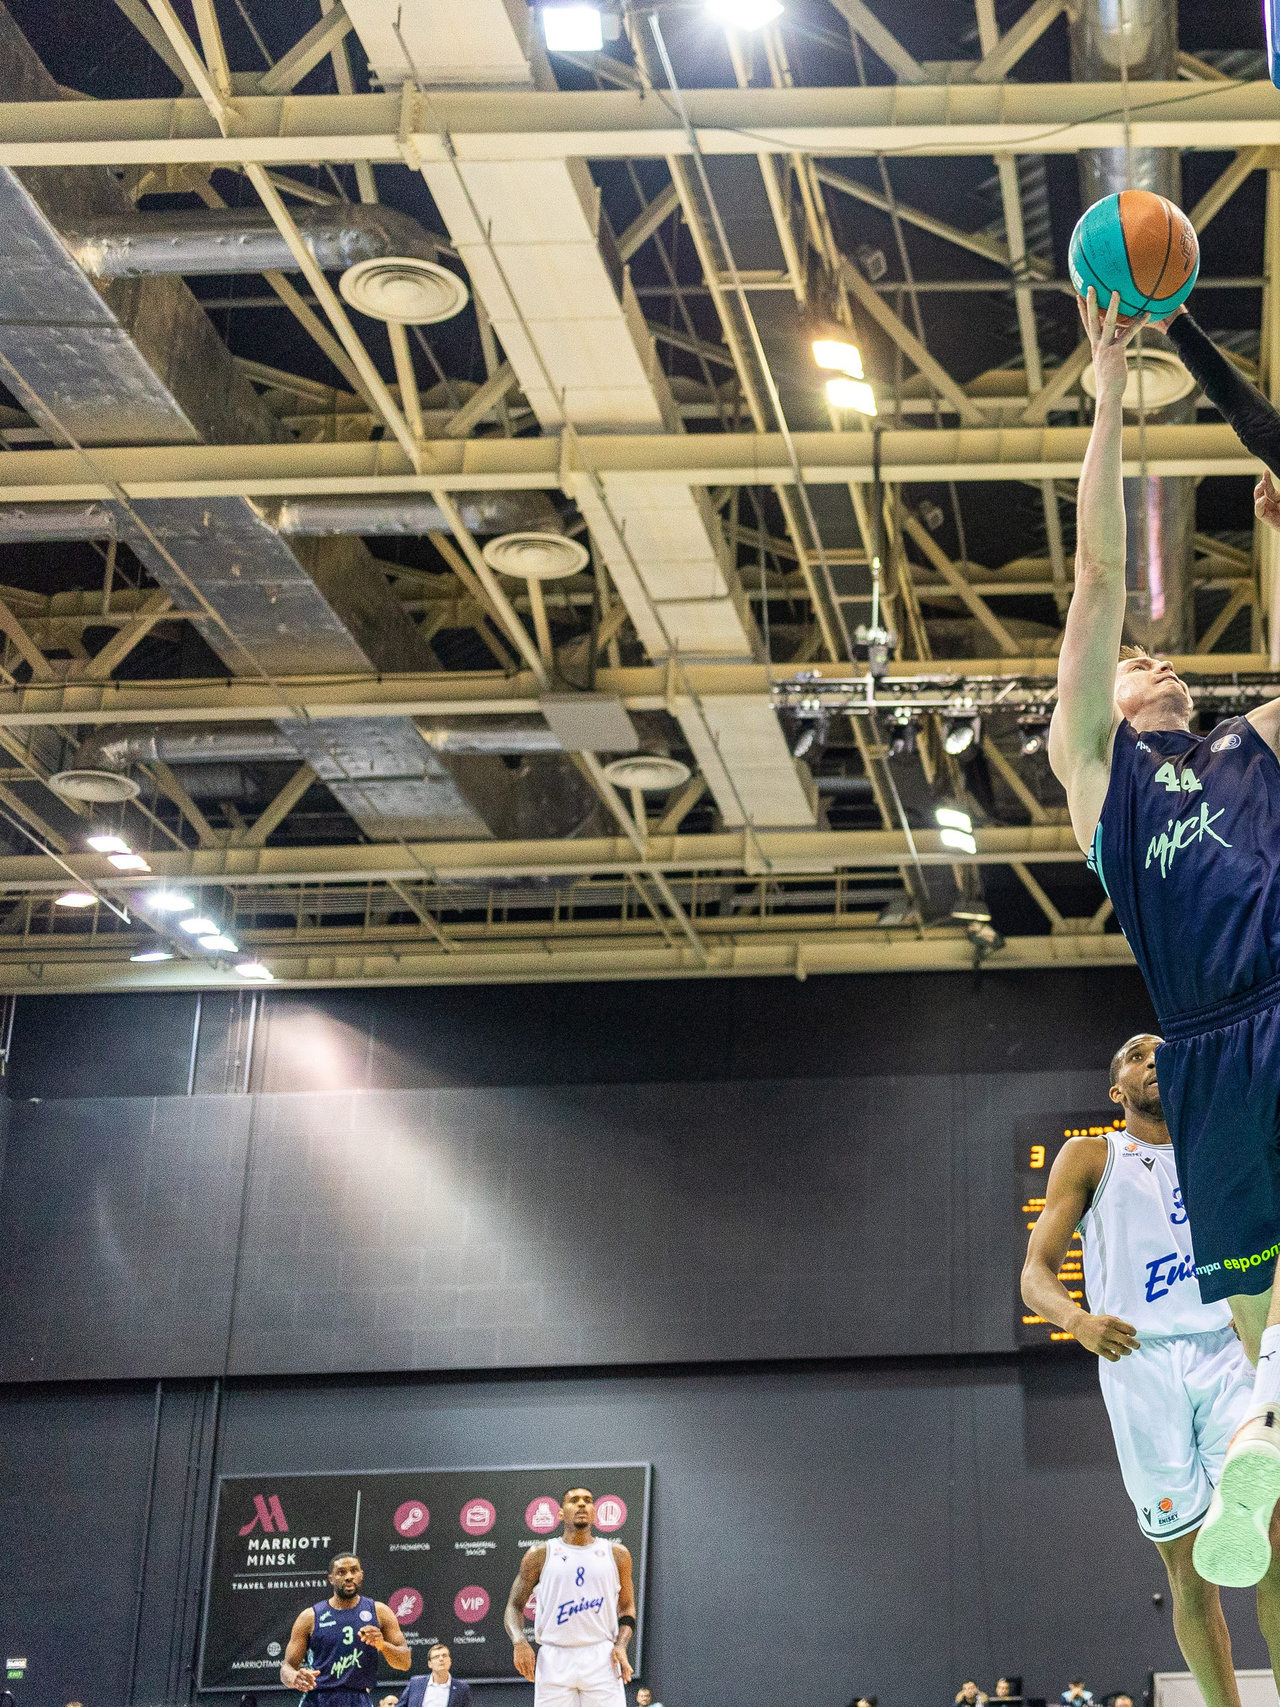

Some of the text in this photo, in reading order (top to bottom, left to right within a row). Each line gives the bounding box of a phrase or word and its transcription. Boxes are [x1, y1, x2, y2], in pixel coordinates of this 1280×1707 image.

[1154, 762, 1203, 793] 44
[1030, 1145, 1045, 1168] 3
[1145, 1252, 1199, 1303] Eni
[248, 1536, 331, 1551] MARRIOTT
[246, 1553, 296, 1566] MINSK
[232, 1582, 265, 1590] TRAVEL
[575, 1566, 585, 1587] 8
[460, 1597, 484, 1611] VIP
[557, 1596, 604, 1626] Enisey
[342, 1626, 353, 1645] 3
